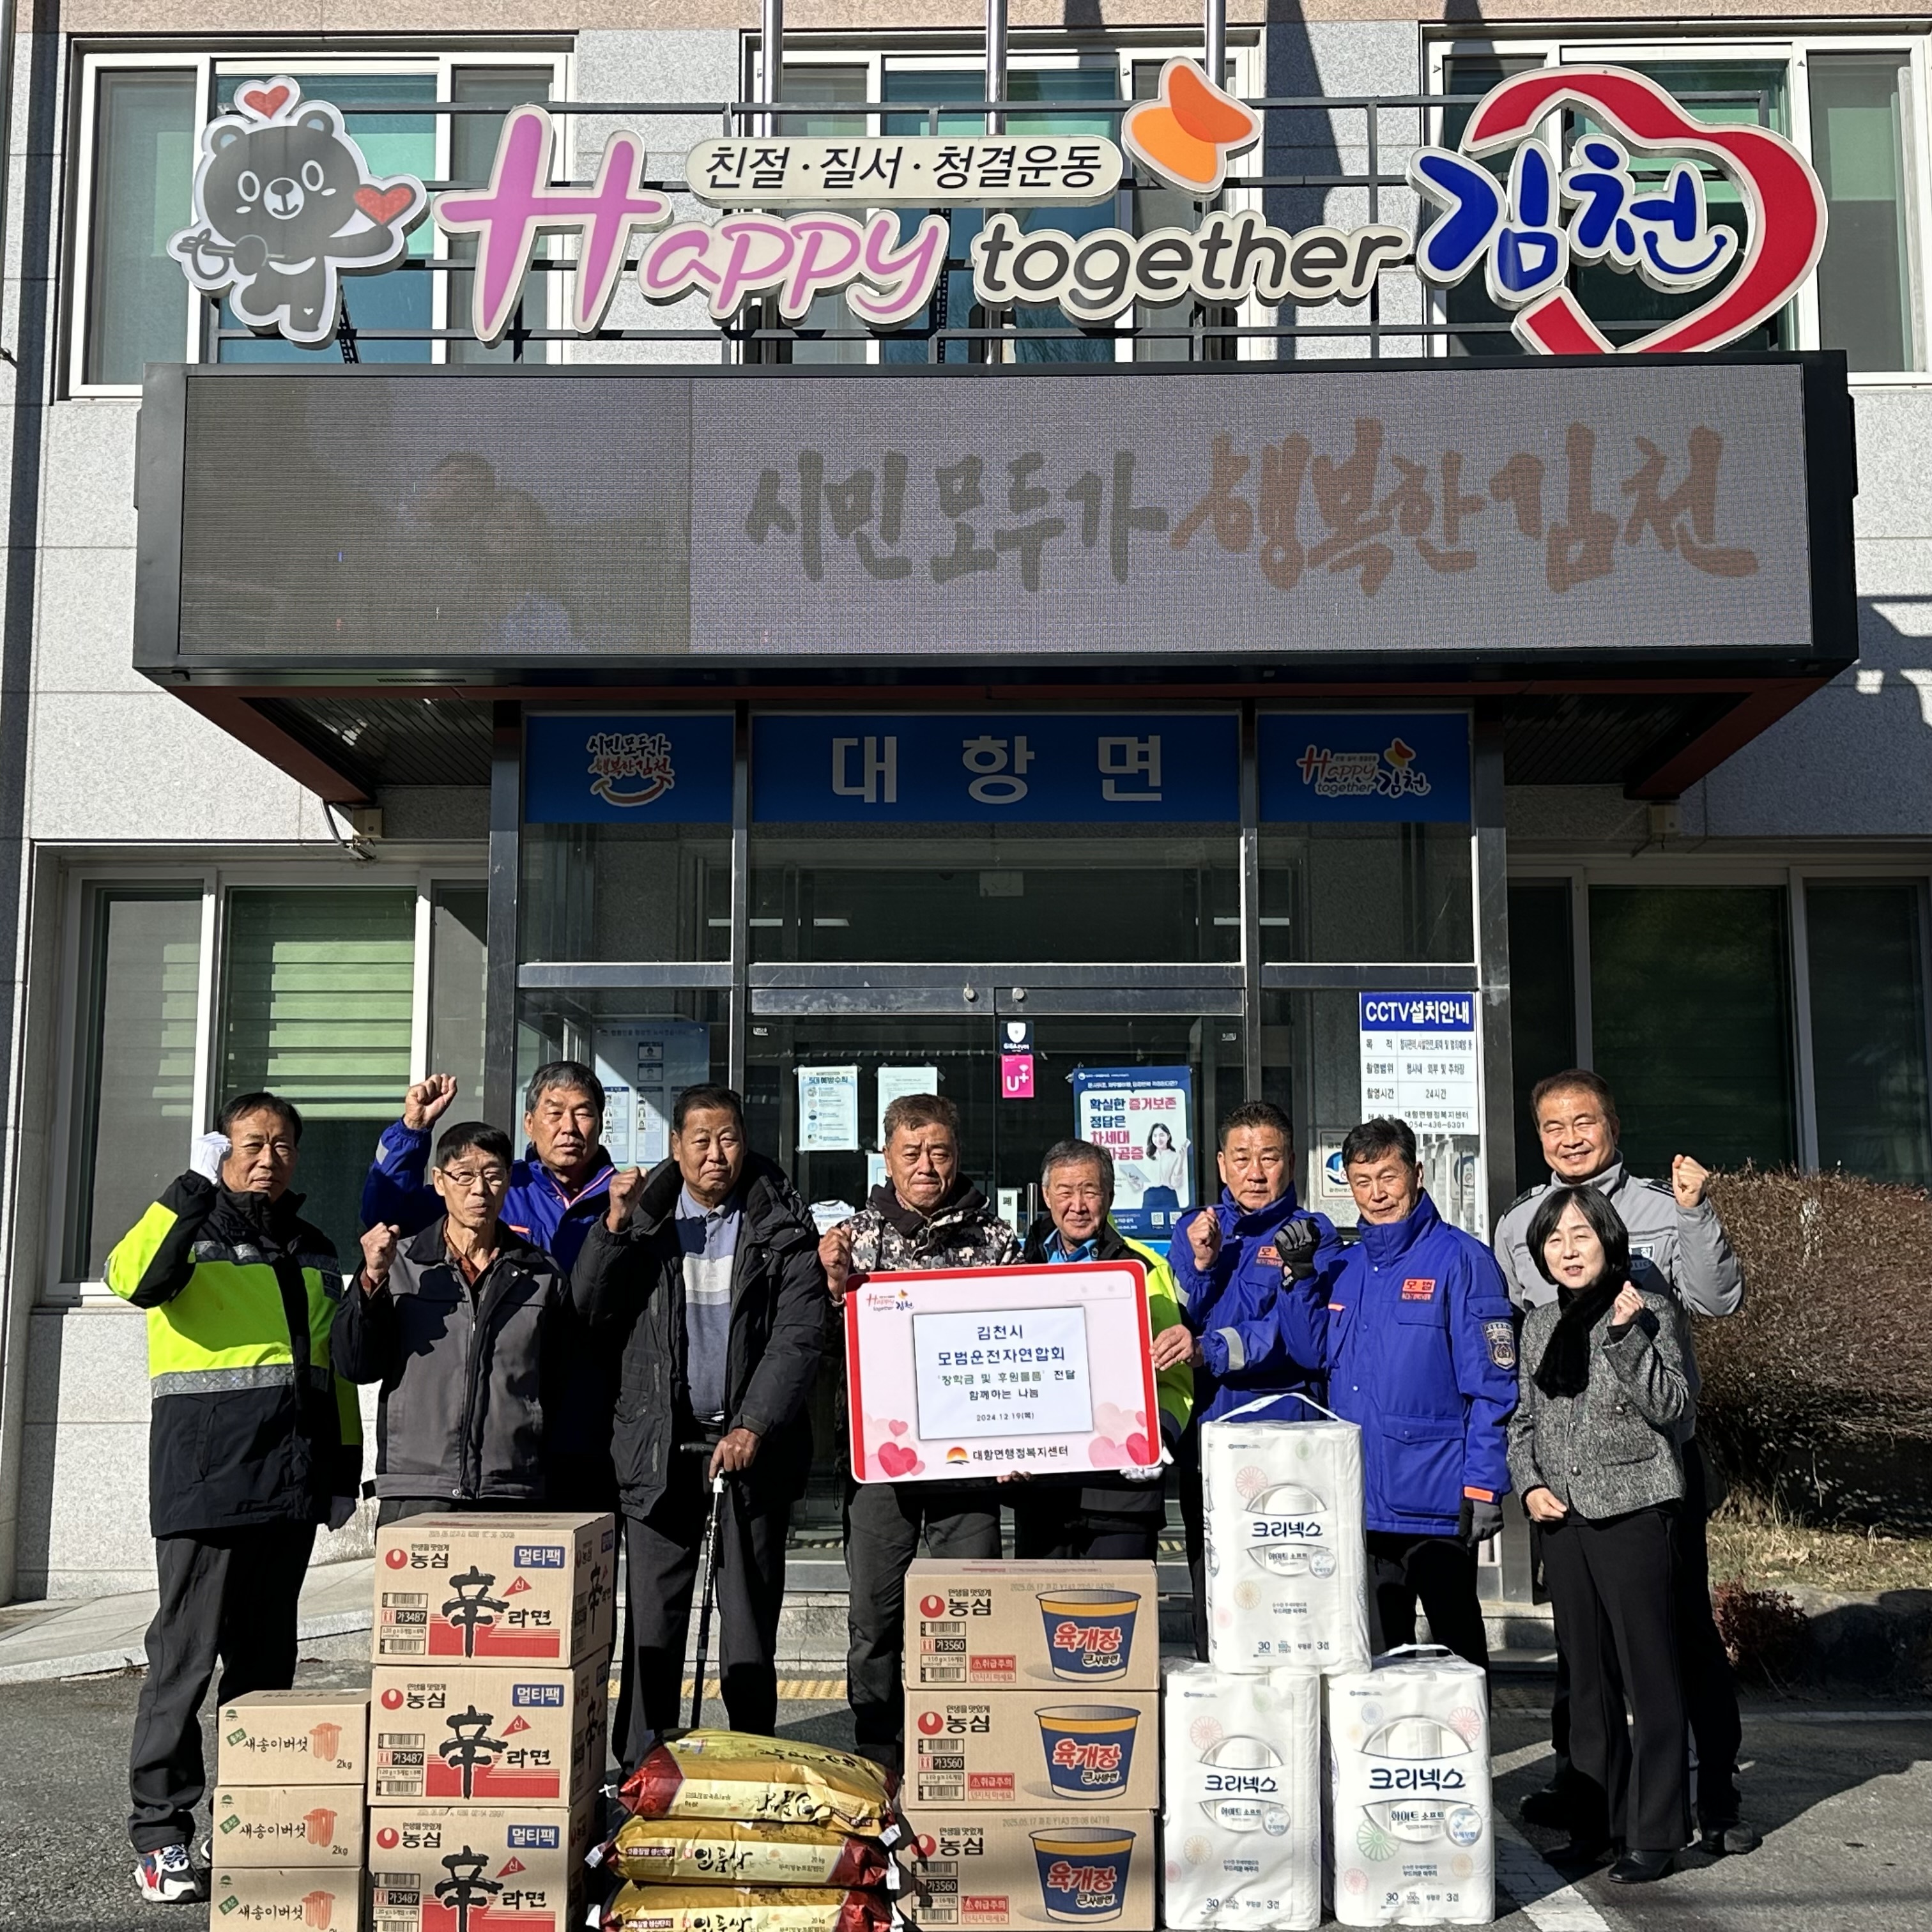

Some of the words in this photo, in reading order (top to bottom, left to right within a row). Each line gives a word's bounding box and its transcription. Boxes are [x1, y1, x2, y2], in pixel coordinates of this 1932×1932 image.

[441, 114, 939, 332] Happy
[980, 220, 1402, 310] together
[1419, 142, 1728, 292] 김천
[1300, 747, 1376, 781] Happy
[1317, 782, 1374, 794] together
[1378, 770, 1429, 795] 김천
[1367, 1087, 1394, 1100] 촬영시간
[1425, 1088, 1446, 1100] 24시간
[1089, 1098, 1126, 1112] 확실한
[1129, 1096, 1176, 1110] 증거보존
[1090, 1115, 1126, 1128] 정답은
[1090, 1130, 1130, 1145] 차세대
[976, 1324, 1023, 1340] 김천시
[937, 1346, 1066, 1367] 모범운전자연합회
[981, 1373, 991, 1384] 및
[1054, 1369, 1076, 1381] 전달
[969, 1389, 1012, 1401] 함께하는
[1018, 1388, 1039, 1399] 나눔
[972, 1445, 1069, 1461] 대항면행정복지센터
[1251, 1521, 1323, 1538] 크리넥스
[410, 1552, 448, 1568] 농심
[518, 1547, 561, 1567] 멀티팩
[514, 1581, 525, 1591] 신
[441, 1565, 510, 1658] 辛
[508, 1609, 551, 1628] 라면
[948, 1598, 992, 1616] 농심
[1054, 1622, 1123, 1653] 육개장
[1257, 1641, 1271, 1650] 30
[981, 1658, 1013, 1669] 취급주의
[1082, 1653, 1119, 1667] 큰사발면
[406, 1689, 446, 1709] 농심
[517, 1686, 560, 1705] 멀티팩
[514, 1719, 524, 1729] 신
[946, 1715, 990, 1733] 농심
[242, 1736, 308, 1752] 새송이버섯
[439, 1705, 509, 1800] 辛
[507, 1749, 551, 1767] 라면
[1053, 1738, 1121, 1769] 육개장
[336, 1759, 352, 1770] 2kg
[980, 1776, 1012, 1787] 취급주의
[1082, 1770, 1119, 1785] 큰사발면
[1204, 1774, 1278, 1794] 크리넥스
[1369, 1768, 1466, 1791] 크리넥스
[239, 1822, 306, 1840] 새송이버섯
[401, 1830, 441, 1848] 농심
[512, 1828, 555, 1846] 멀티팩
[332, 1845, 348, 1855] 2kg
[939, 1837, 983, 1857] 농심
[508, 1862, 519, 1872] 신
[694, 1845, 753, 1873] 일품쌀
[1048, 1861, 1116, 1892] 육개장
[434, 1845, 504, 1932] 辛
[502, 1890, 546, 1910] 라면
[1386, 1892, 1399, 1901] 30
[974, 1899, 1006, 1910] 취급주의
[1077, 1894, 1113, 1908] 큰사발면
[1206, 1897, 1219, 1907] 30
[237, 1904, 303, 1921] 새송이버섯
